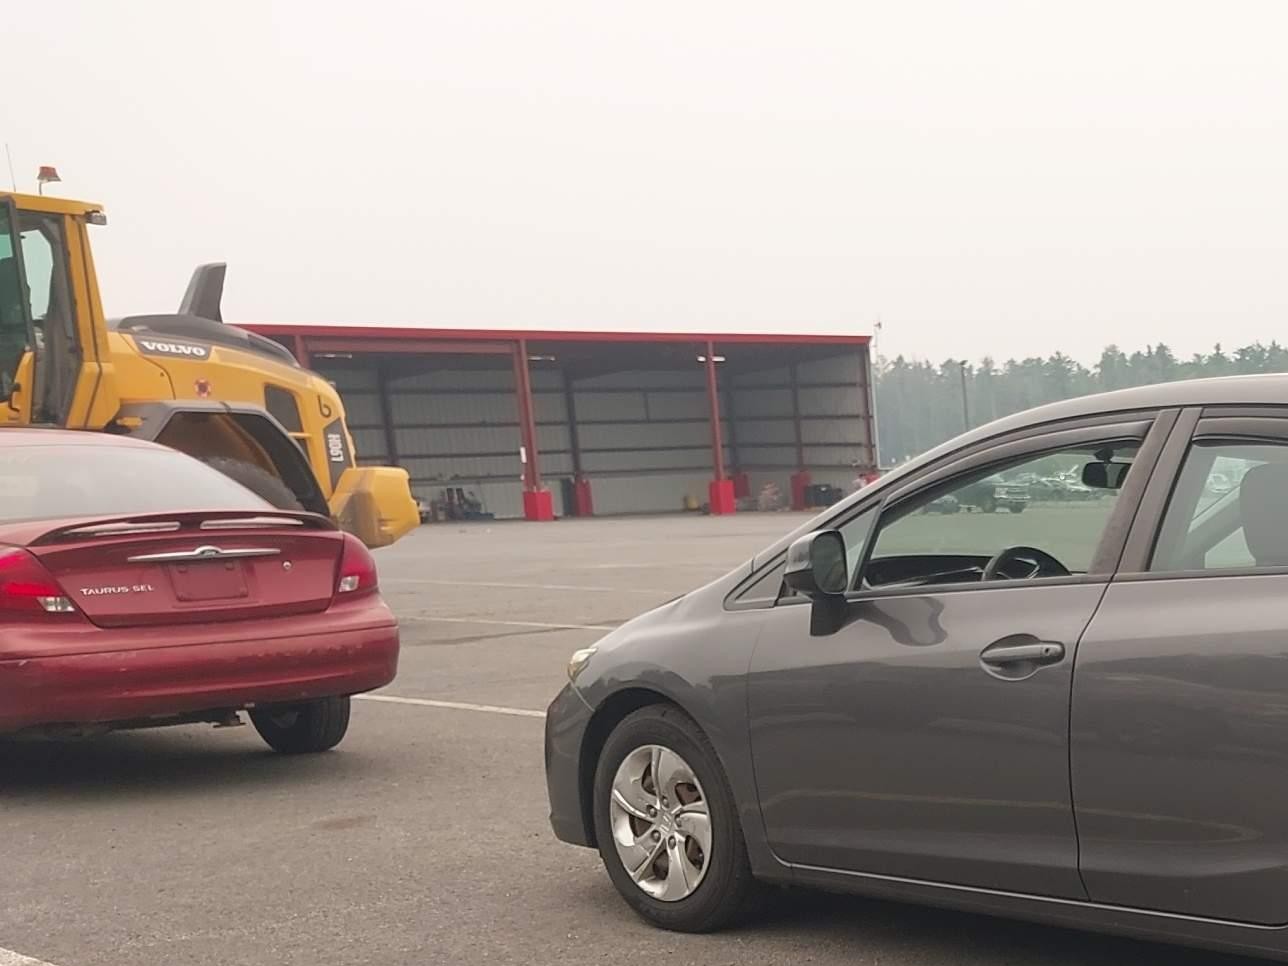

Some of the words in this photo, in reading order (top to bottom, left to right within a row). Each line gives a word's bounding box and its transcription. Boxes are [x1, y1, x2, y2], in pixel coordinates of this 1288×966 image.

[141, 341, 206, 356] VOLVO
[327, 433, 344, 462] L90H
[80, 586, 129, 595] TAURUS
[132, 584, 154, 593] SEL
